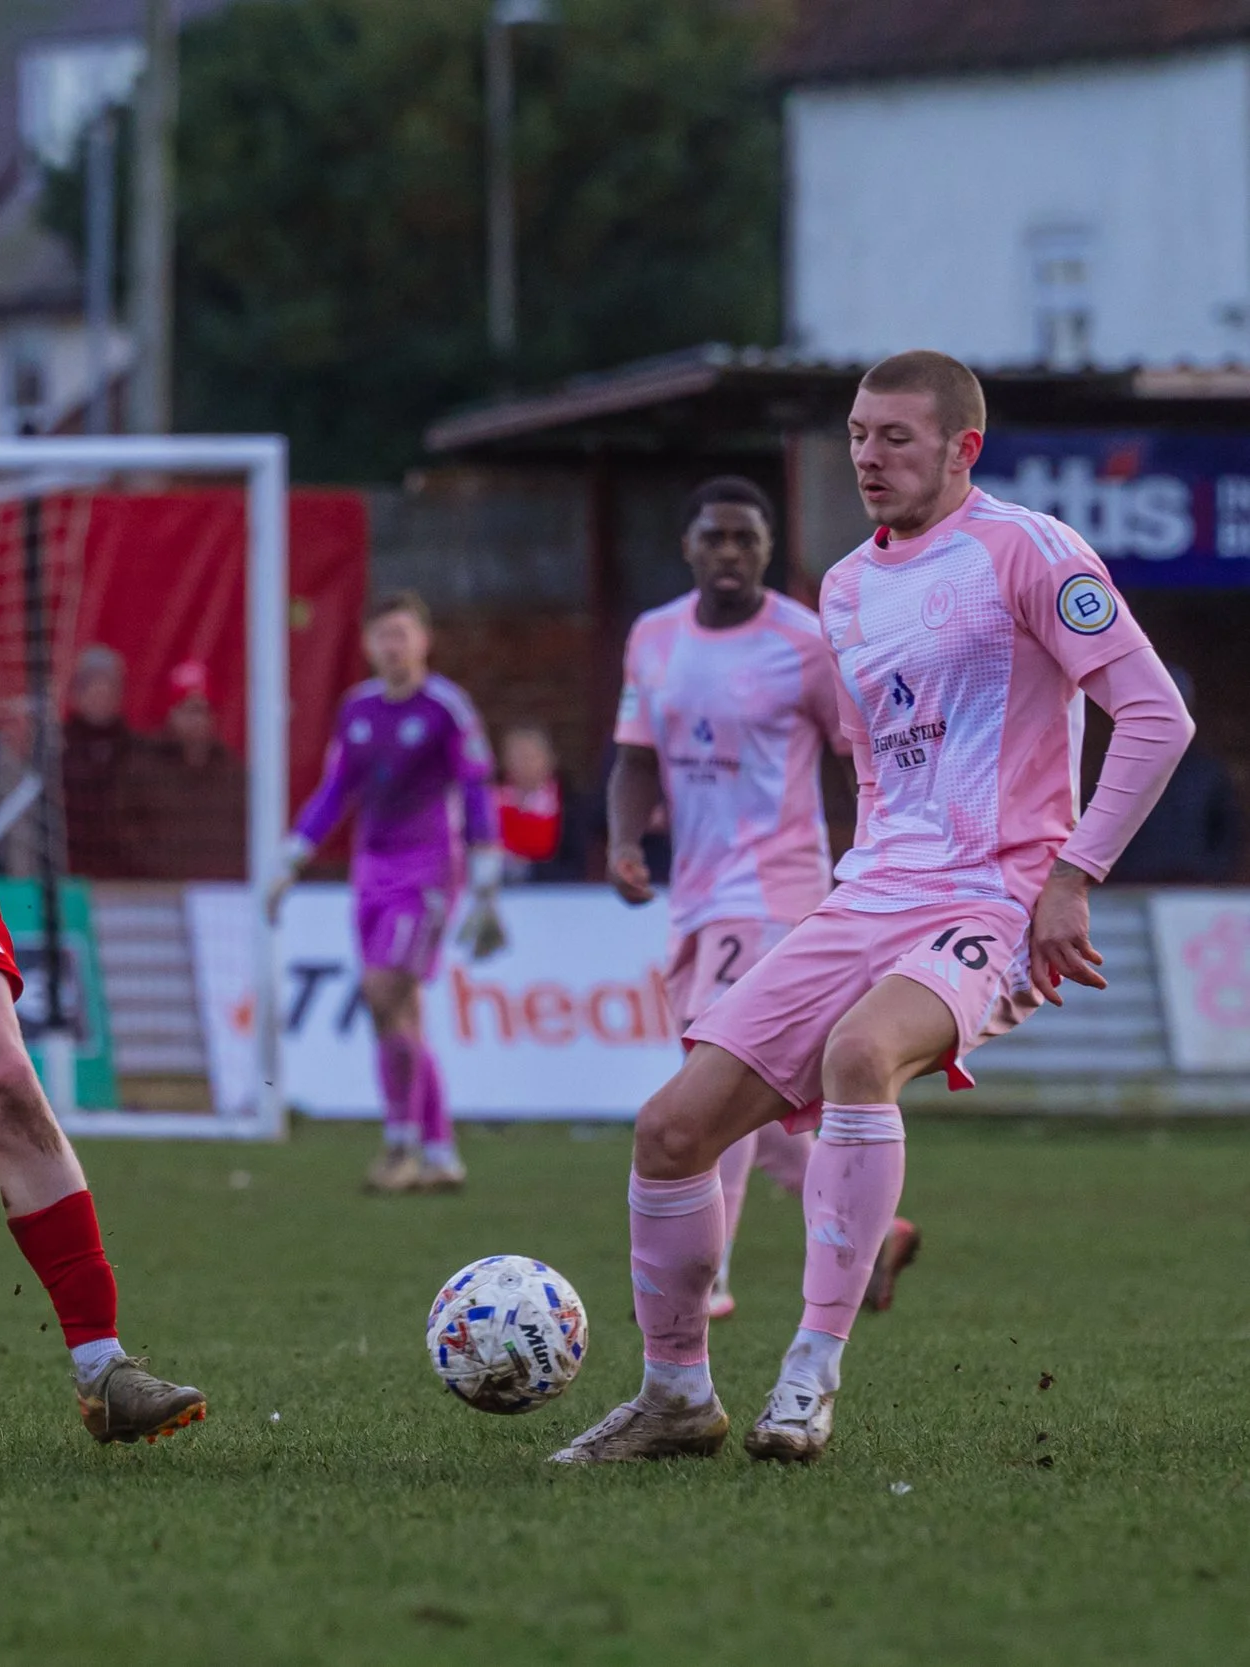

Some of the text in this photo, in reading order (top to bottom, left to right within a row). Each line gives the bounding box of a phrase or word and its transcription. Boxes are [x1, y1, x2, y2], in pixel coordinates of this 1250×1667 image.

[1074, 592, 1101, 618] B
[715, 934, 742, 986] 2
[931, 926, 998, 970] 16
